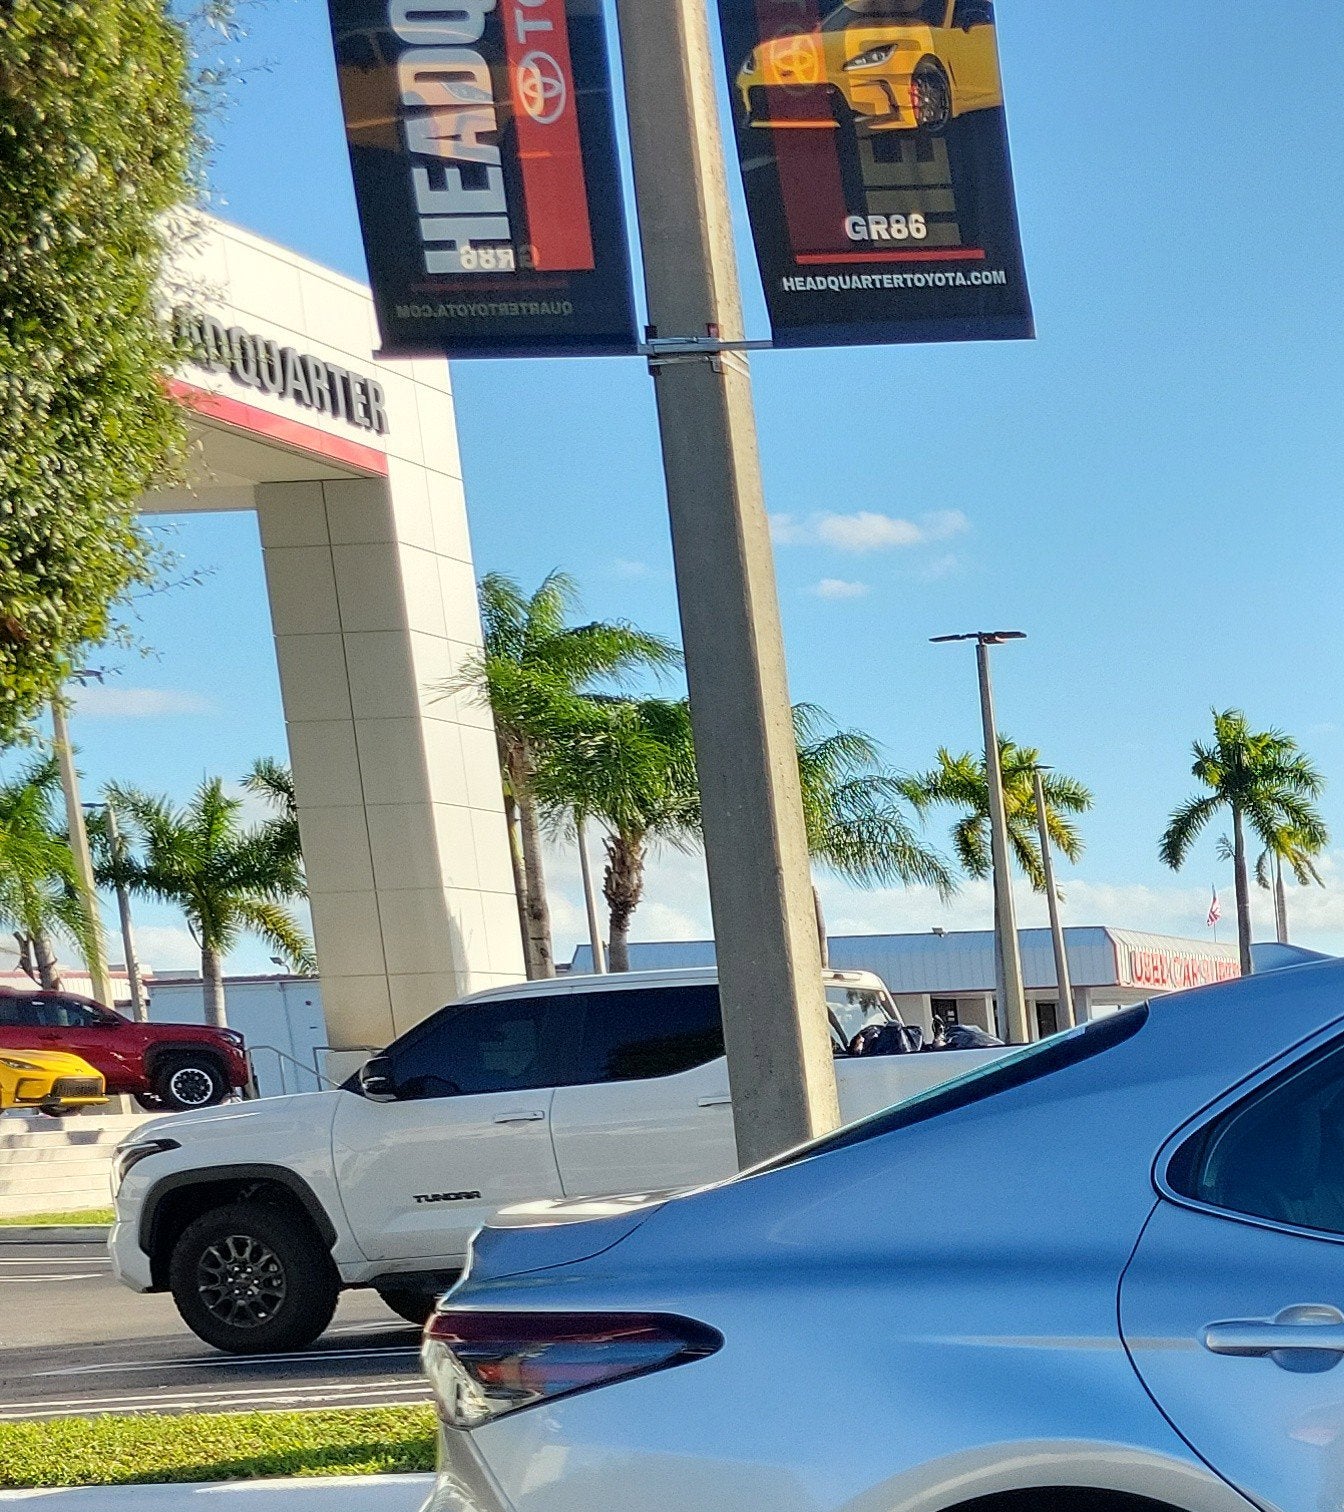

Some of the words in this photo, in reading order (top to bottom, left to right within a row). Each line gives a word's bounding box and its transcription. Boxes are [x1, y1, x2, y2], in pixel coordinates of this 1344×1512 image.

[845, 214, 928, 241] GR86
[782, 270, 1008, 292] HEADQUARTERTOYOTA.COM
[412, 1190, 481, 1203] TUNDRA
